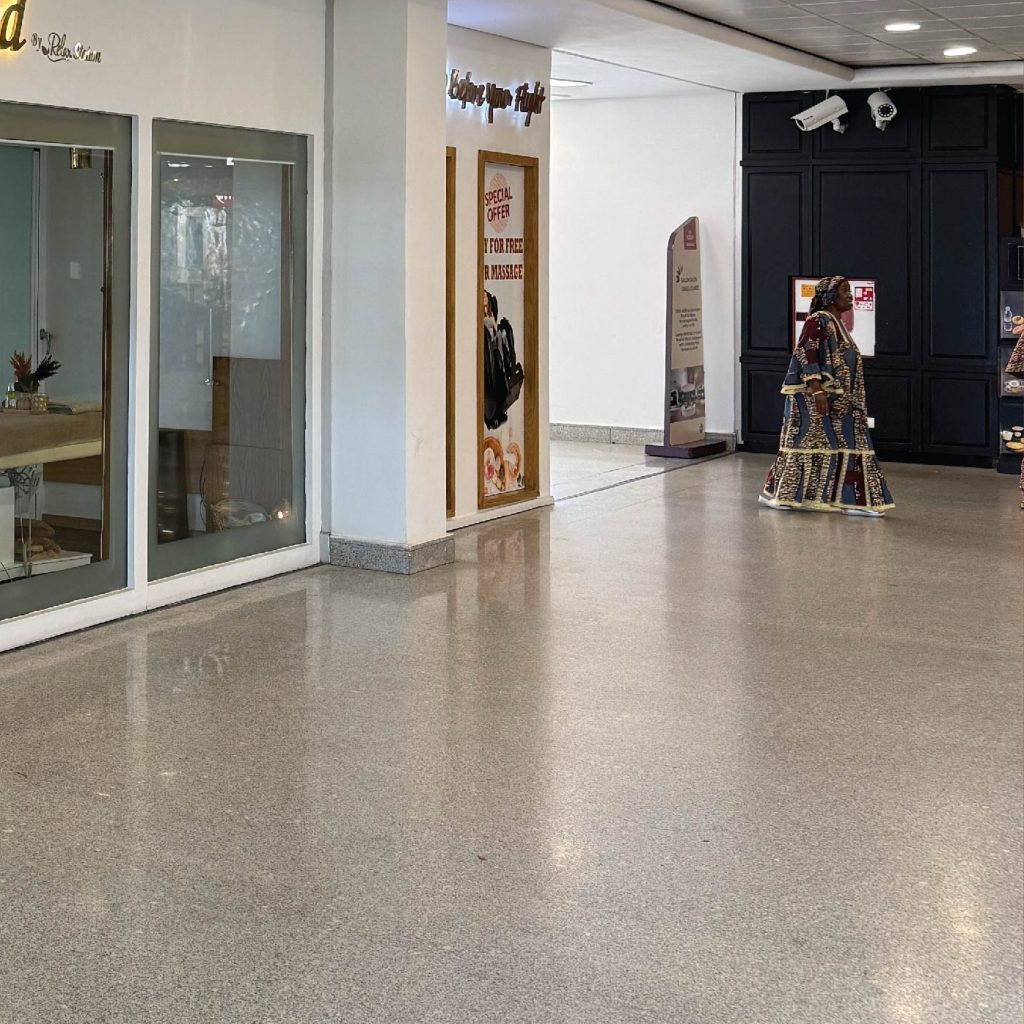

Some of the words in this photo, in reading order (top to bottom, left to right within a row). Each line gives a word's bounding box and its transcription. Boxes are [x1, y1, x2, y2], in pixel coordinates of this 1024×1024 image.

[484, 186, 513, 207] SPECIAL
[487, 204, 510, 222] OFFER
[489, 238, 505, 254] FOR
[505, 238, 524, 254] FREE
[490, 263, 523, 281] MASSAGE
